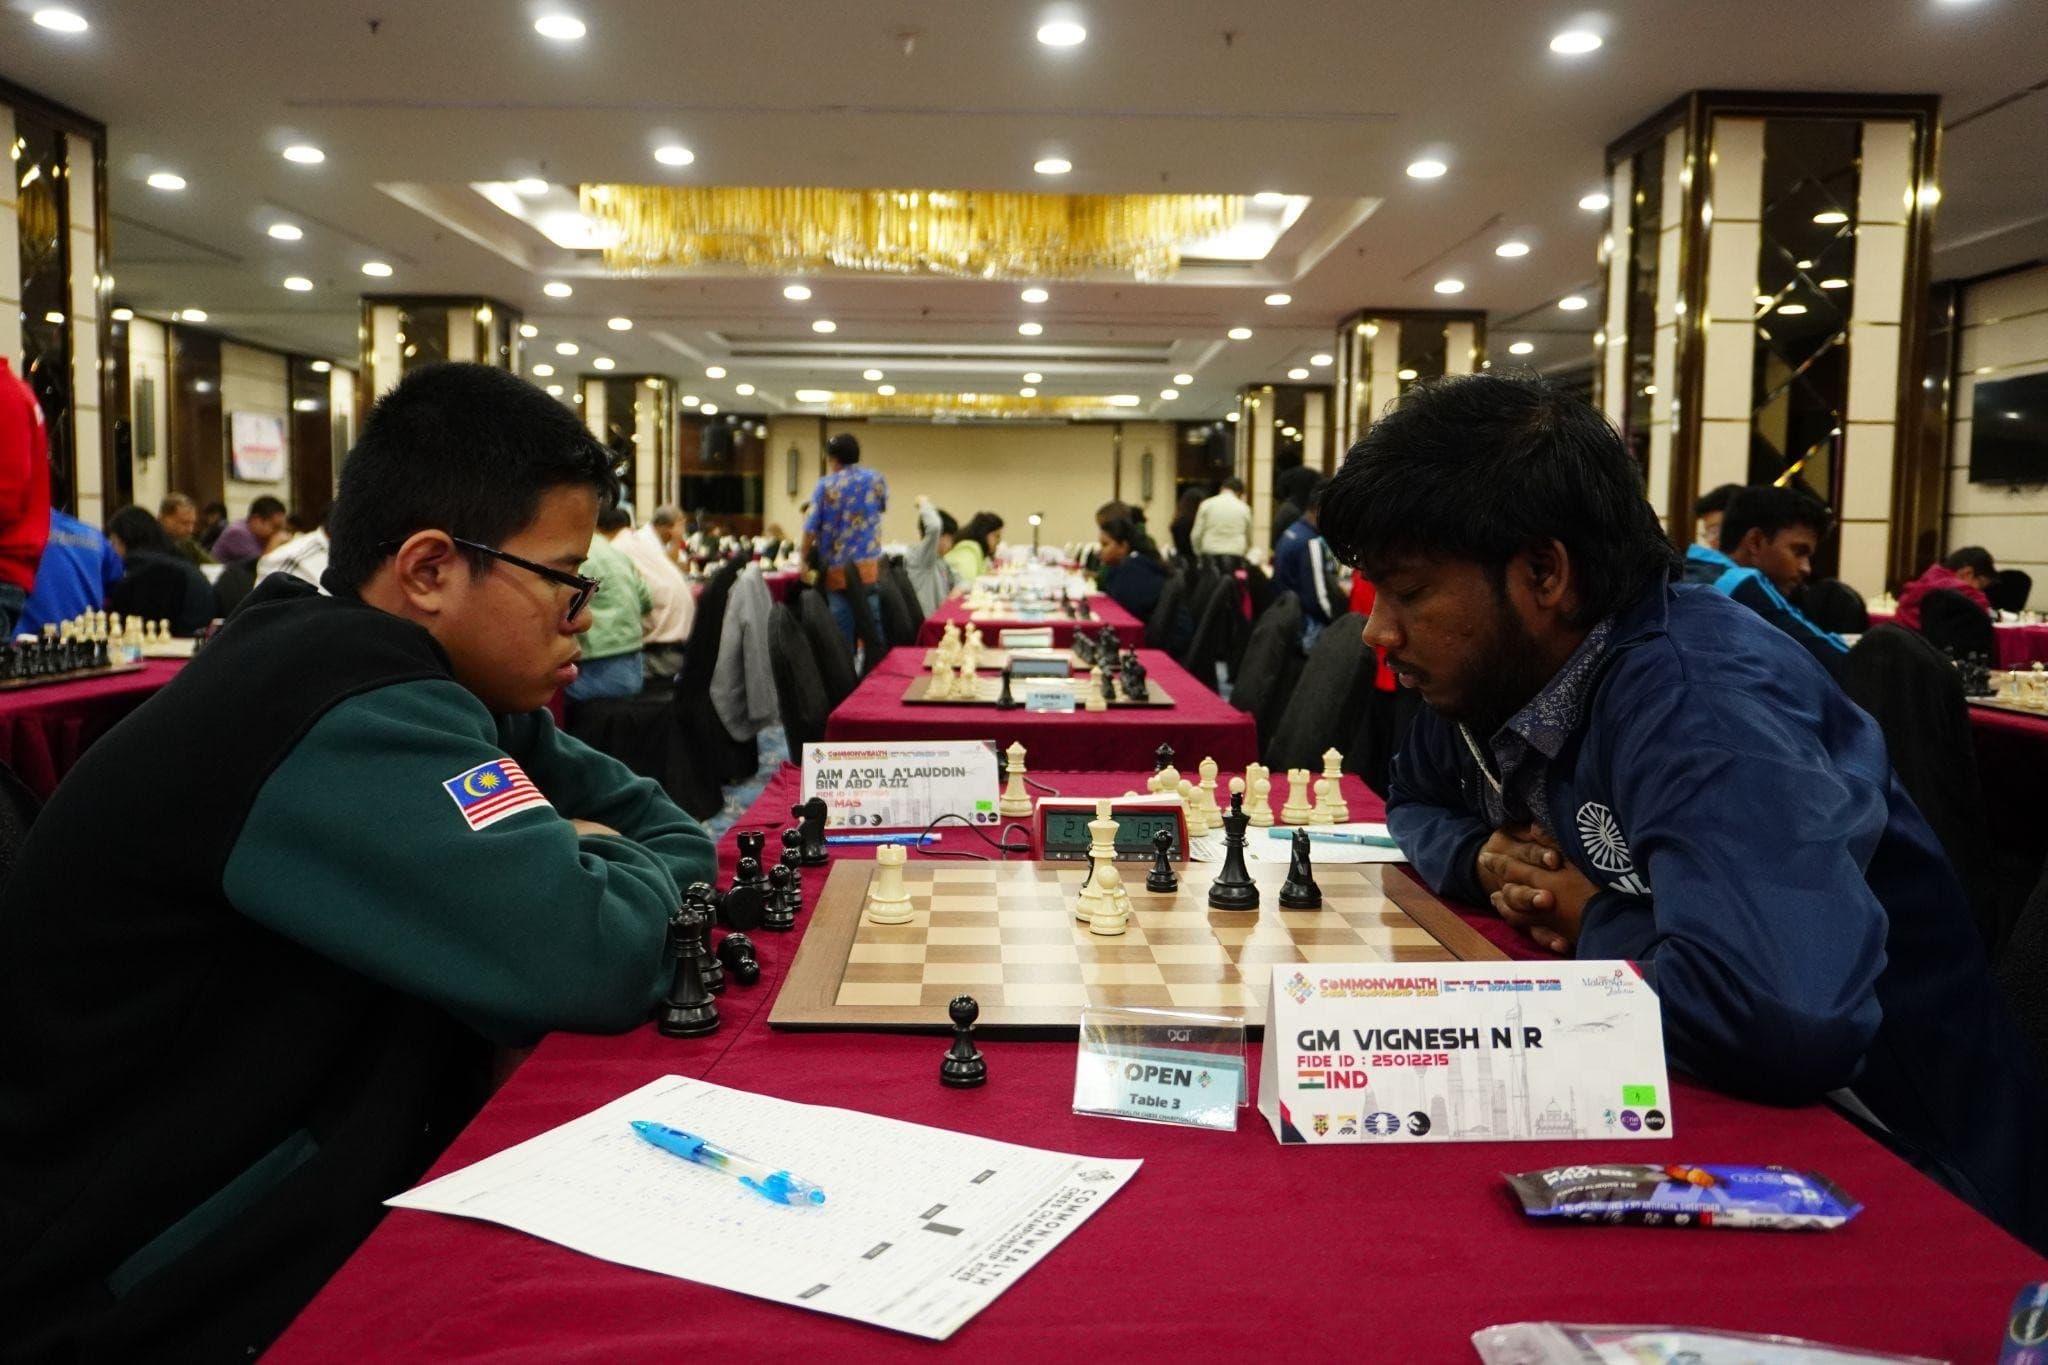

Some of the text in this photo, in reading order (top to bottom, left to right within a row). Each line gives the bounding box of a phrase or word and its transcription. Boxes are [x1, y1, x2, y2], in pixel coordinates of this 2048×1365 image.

[815, 767, 966, 780] AIM A'QIL A'LAUDDIN
[815, 778, 909, 789] BIN ABD AZIZ
[835, 800, 862, 808] MAS
[1319, 977, 1438, 990] COMMONWEALTH
[1296, 1027, 1543, 1051] GM VIGNESH N R
[1297, 1055, 1332, 1067] FIDE
[1338, 1055, 1355, 1067] ID
[1371, 1053, 1450, 1067] 25012215
[1124, 1063, 1193, 1088] OPEN
[1325, 1070, 1369, 1090] IND
[1129, 1093, 1181, 1110] Table 3
[972, 1189, 1098, 1286] COMMONWEALTH
